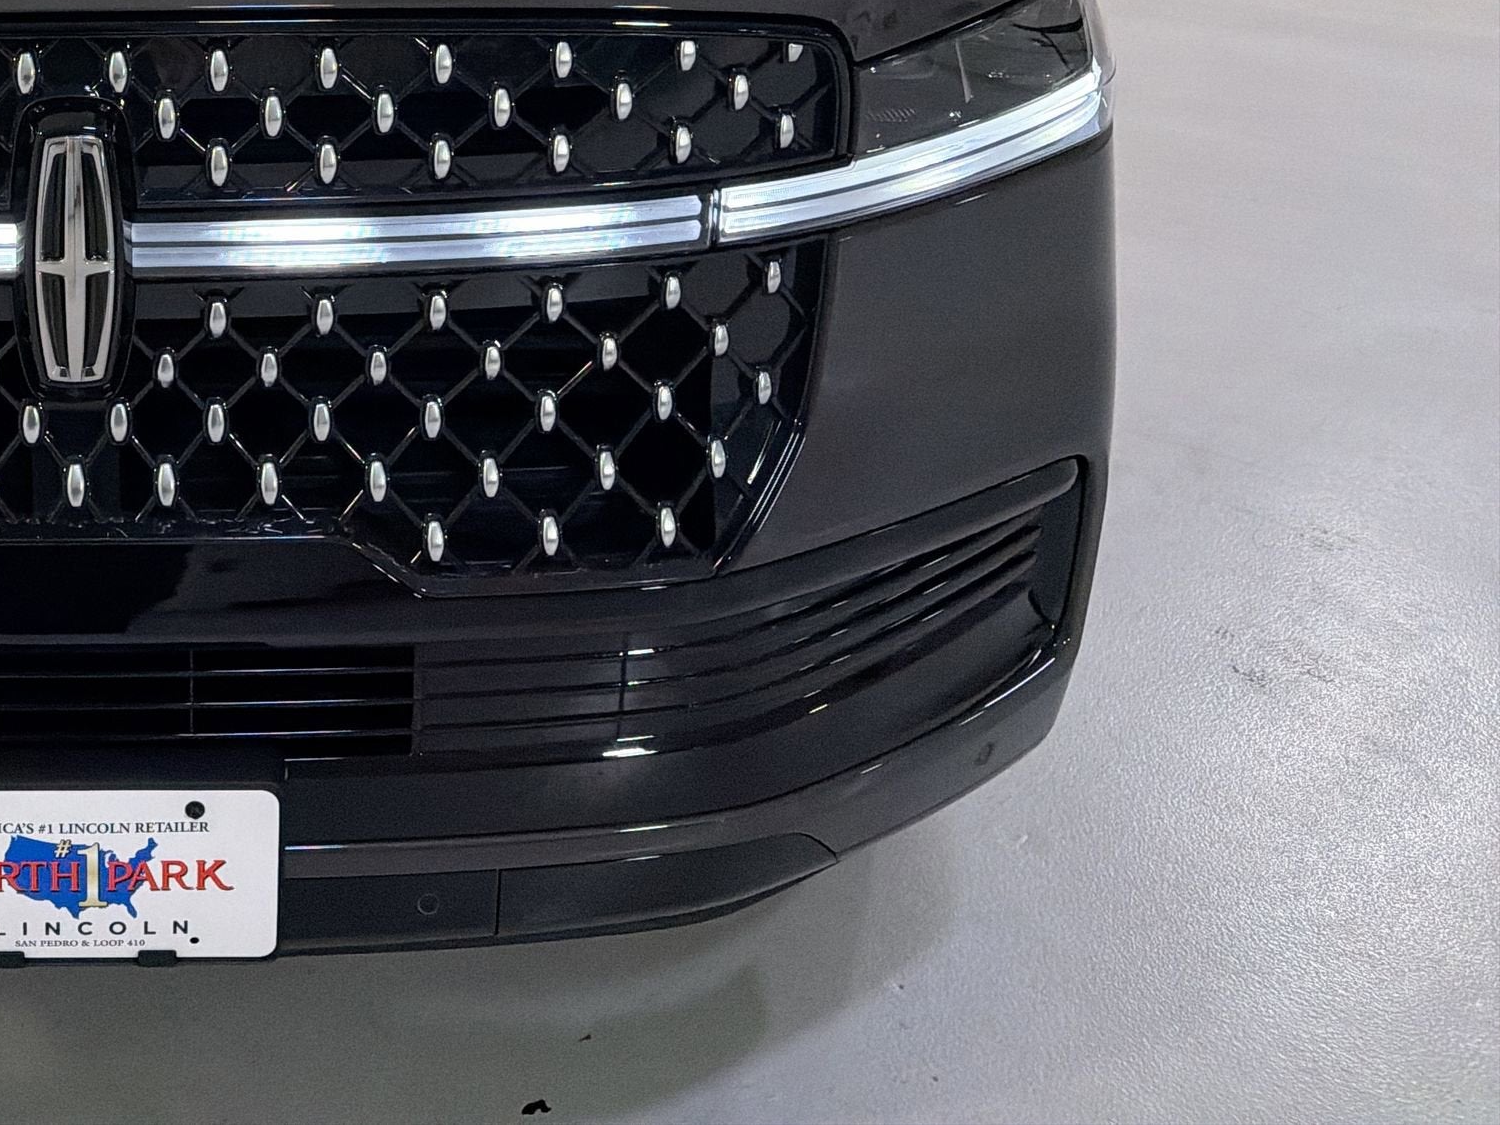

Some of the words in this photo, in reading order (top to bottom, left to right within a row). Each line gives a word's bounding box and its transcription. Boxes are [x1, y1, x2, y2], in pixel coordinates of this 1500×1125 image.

[38, 823, 53, 835] #1
[59, 823, 131, 835] LINCOLN
[135, 821, 210, 834] RETAILER
[107, 859, 235, 892] PARK
[14, 939, 37, 948] SAN
[40, 938, 79, 948] PEDRO
[81, 939, 91, 947] &
[94, 938, 125, 947] LOOP
[127, 938, 146, 947] 410
